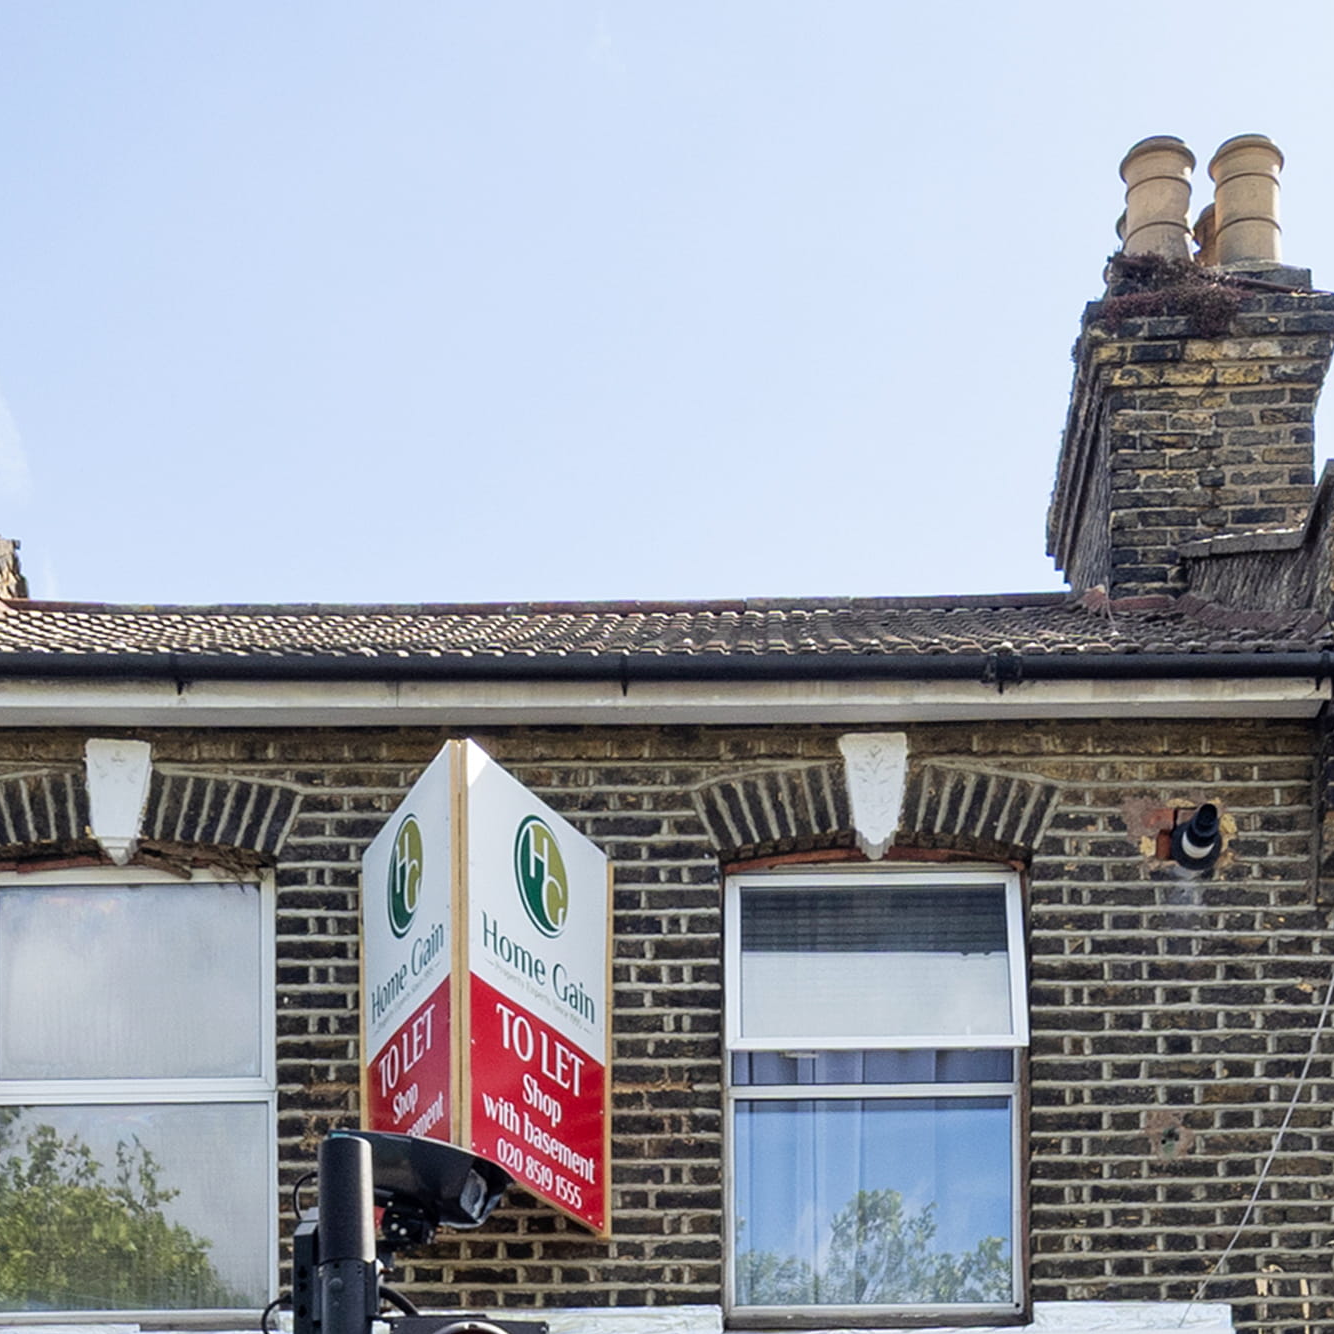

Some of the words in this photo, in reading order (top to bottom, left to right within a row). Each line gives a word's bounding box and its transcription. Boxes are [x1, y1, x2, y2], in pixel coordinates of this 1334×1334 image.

[371, 964, 407, 1025] Home
[411, 923, 444, 977] Gain
[482, 910, 546, 986] Home
[553, 963, 595, 1025] Gain
[379, 1045, 400, 1098] TO
[402, 1003, 436, 1074] LET
[496, 1002, 534, 1062] TO
[540, 1031, 585, 1097] LET
[392, 1082, 419, 1125] Shop
[406, 1091, 444, 1134] ement
[482, 1091, 520, 1136] with
[523, 1111, 596, 1185] basement
[522, 1073, 562, 1128] Shop
[497, 1137, 523, 1173] 020
[525, 1156, 553, 1192] 8519
[555, 1174, 583, 1209] 1555
